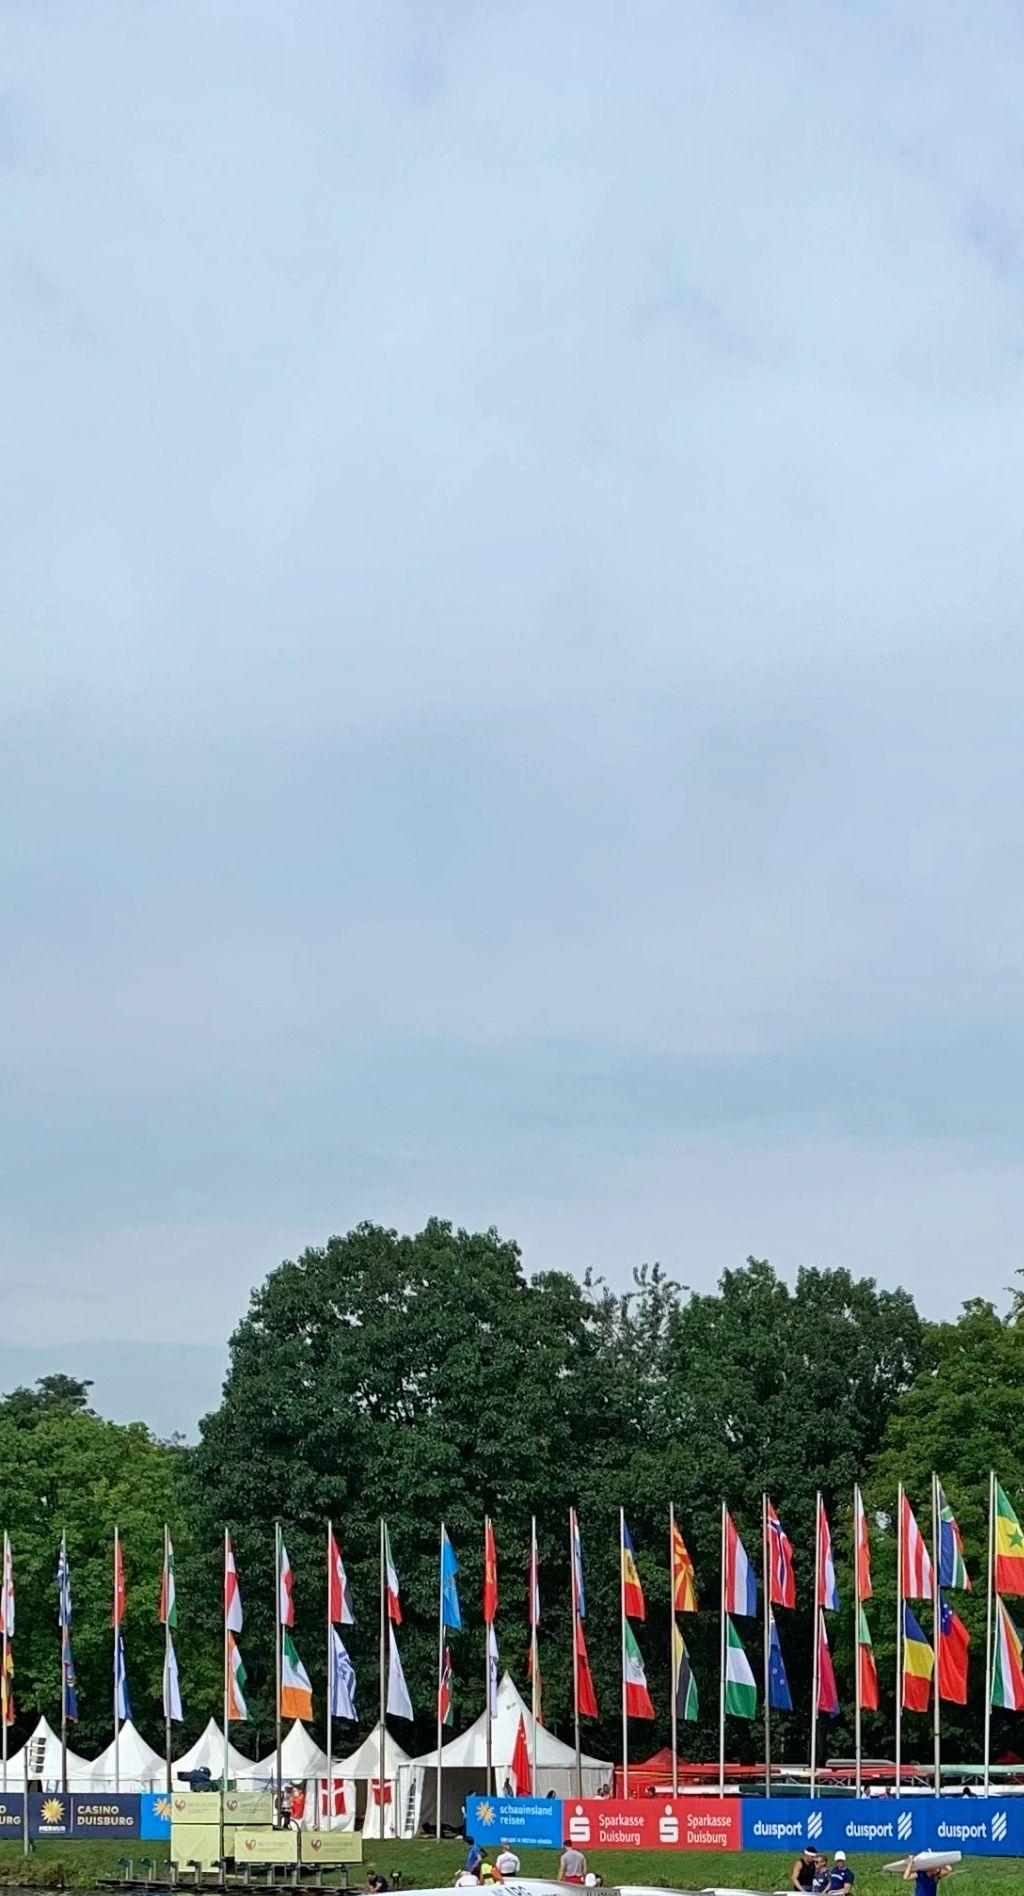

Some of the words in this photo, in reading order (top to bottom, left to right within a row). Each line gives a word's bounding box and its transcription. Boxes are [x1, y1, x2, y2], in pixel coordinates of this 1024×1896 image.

[77, 1805, 119, 1815] CASINO
[500, 1804, 553, 1816] schauinsland
[77, 1816, 134, 1826] DUISBURG
[500, 1816, 526, 1826] reisen
[598, 1814, 645, 1828] Sparkasse
[687, 1814, 732, 1828] Sparkasse
[753, 1820, 803, 1840] duisport
[845, 1821, 894, 1841] duisport
[937, 1821, 987, 1841] duisport
[599, 1831, 641, 1846] Duisburg
[687, 1831, 728, 1846] Duisburg
